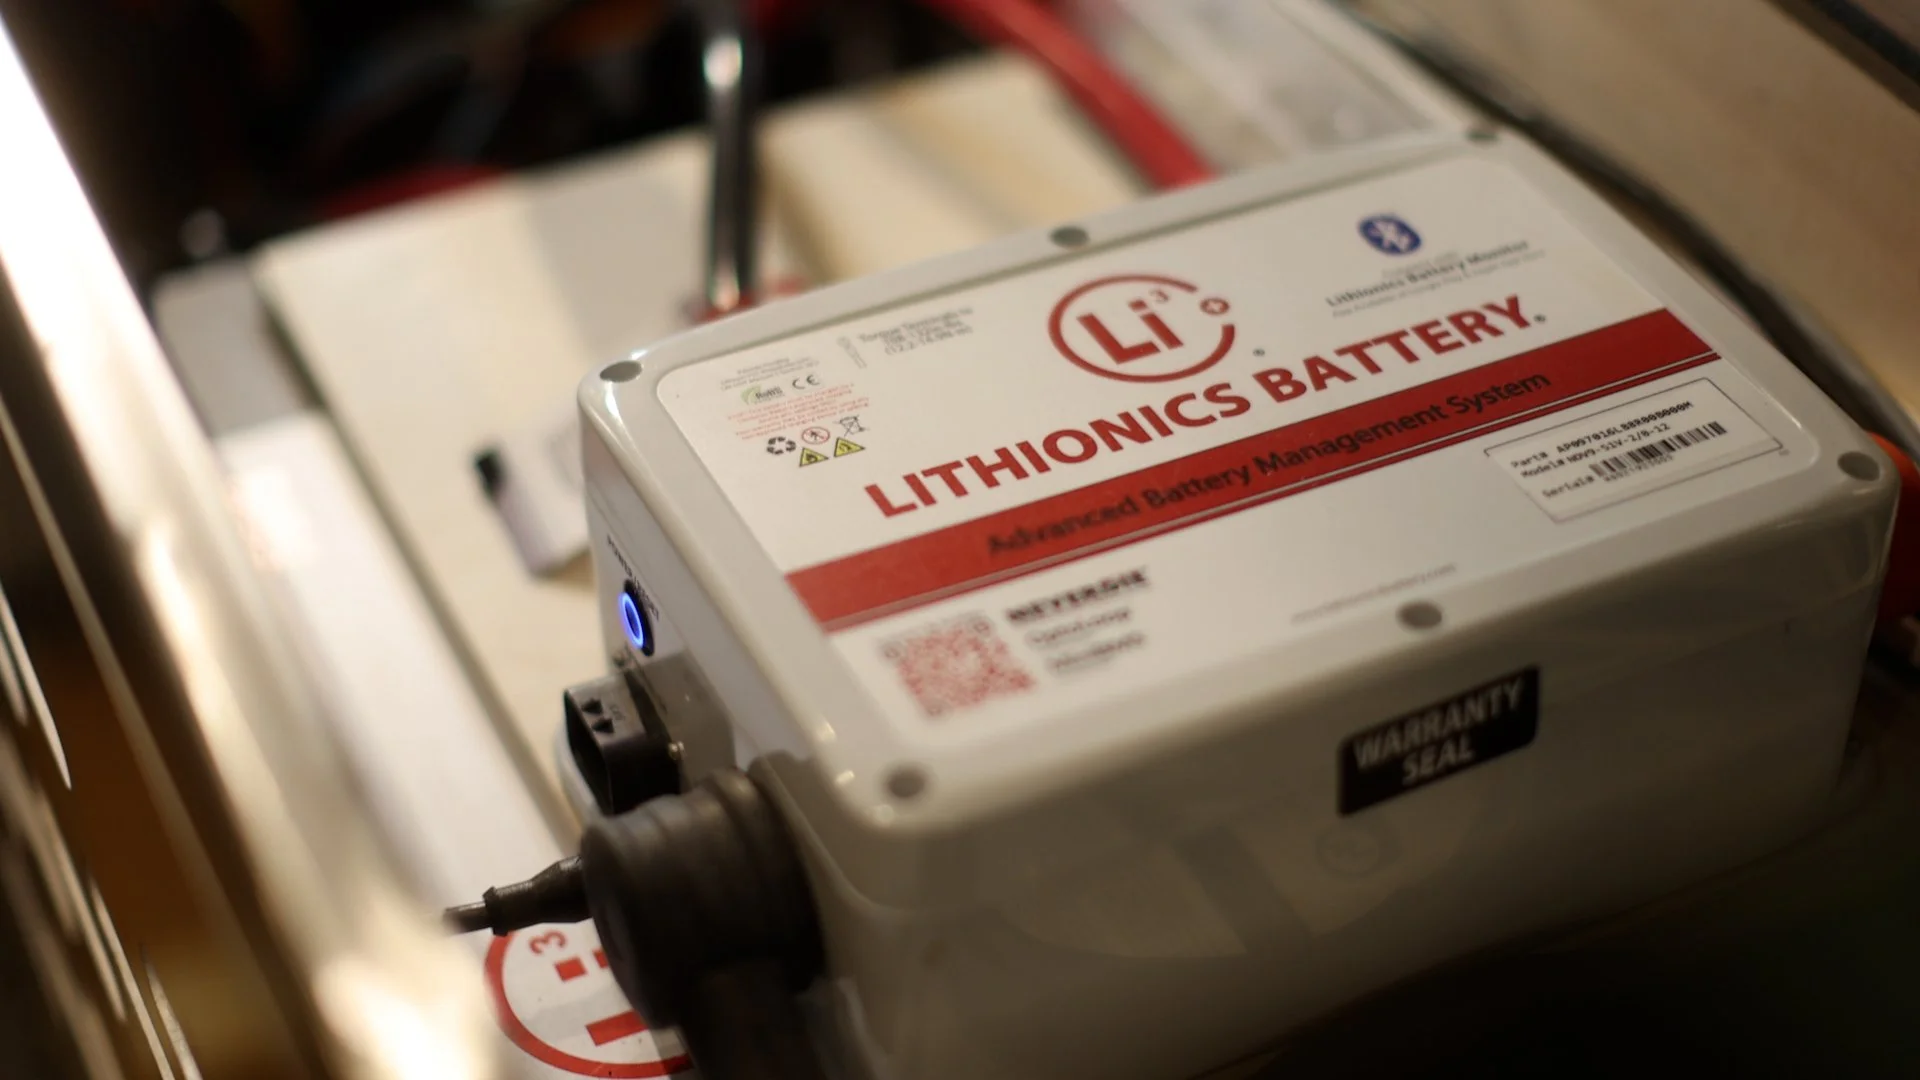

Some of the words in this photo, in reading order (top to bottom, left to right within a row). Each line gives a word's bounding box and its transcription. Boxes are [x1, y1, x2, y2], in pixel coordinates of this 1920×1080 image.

[864, 381, 1252, 519] LITHIONICS
[986, 495, 1143, 556] Advanced
[1140, 463, 1253, 510] Battery
[1251, 398, 1451, 476] Management
[1445, 371, 1552, 416] System
[1352, 674, 1525, 772] WARRANTY
[1402, 731, 1477, 787] SEAL
